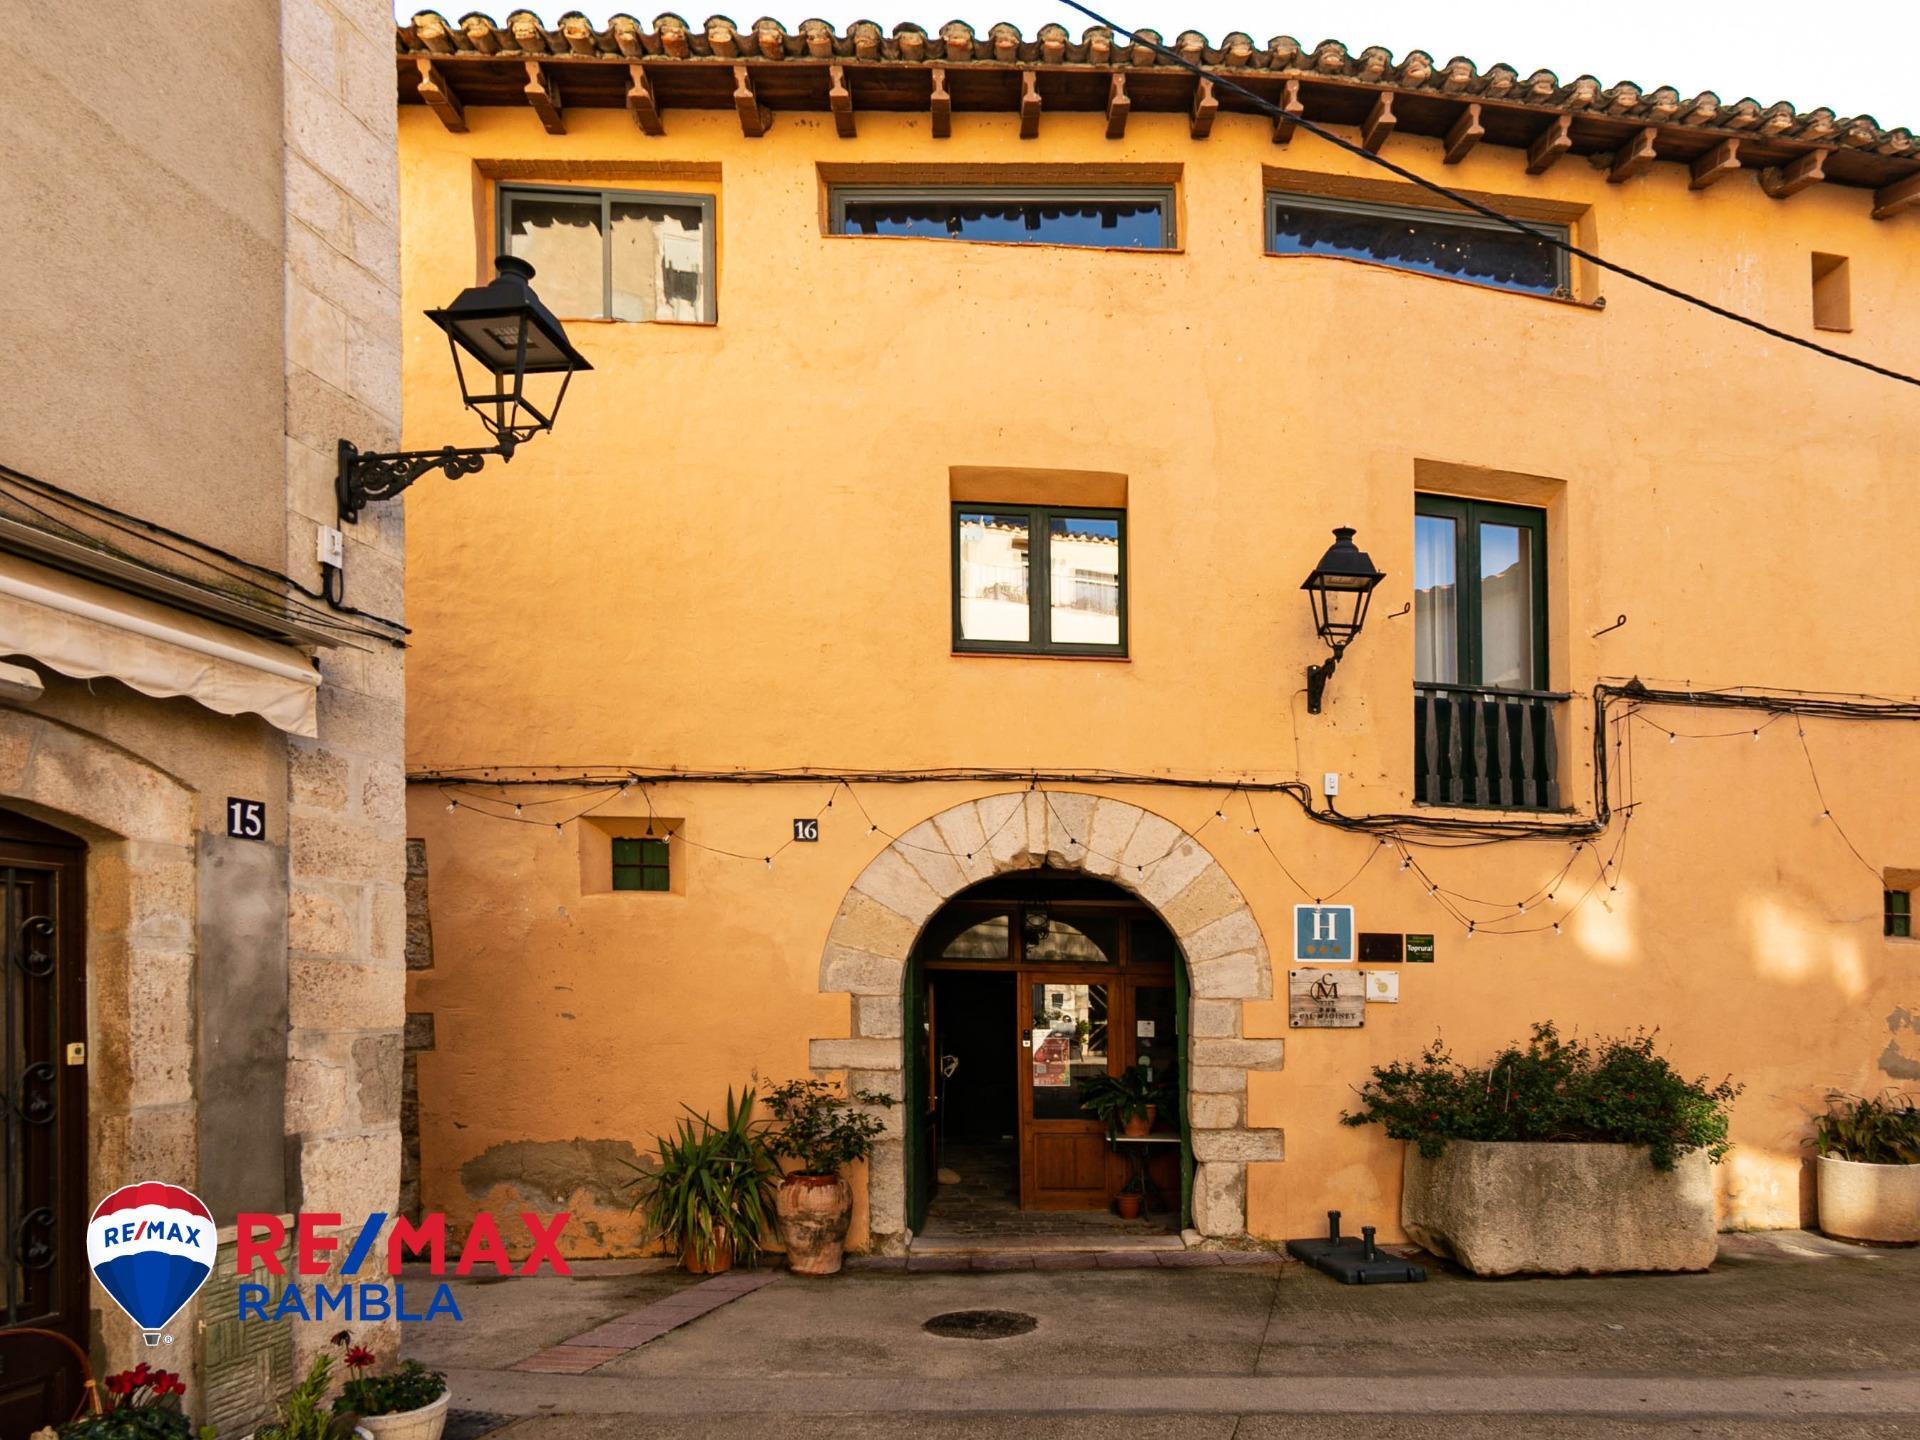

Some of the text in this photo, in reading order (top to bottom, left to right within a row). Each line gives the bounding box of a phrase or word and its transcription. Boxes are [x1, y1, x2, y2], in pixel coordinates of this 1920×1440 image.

[230, 803, 261, 836] 15
[795, 821, 817, 839] 16
[1312, 912, 1338, 941] H
[1407, 944, 1433, 953] Toprural
